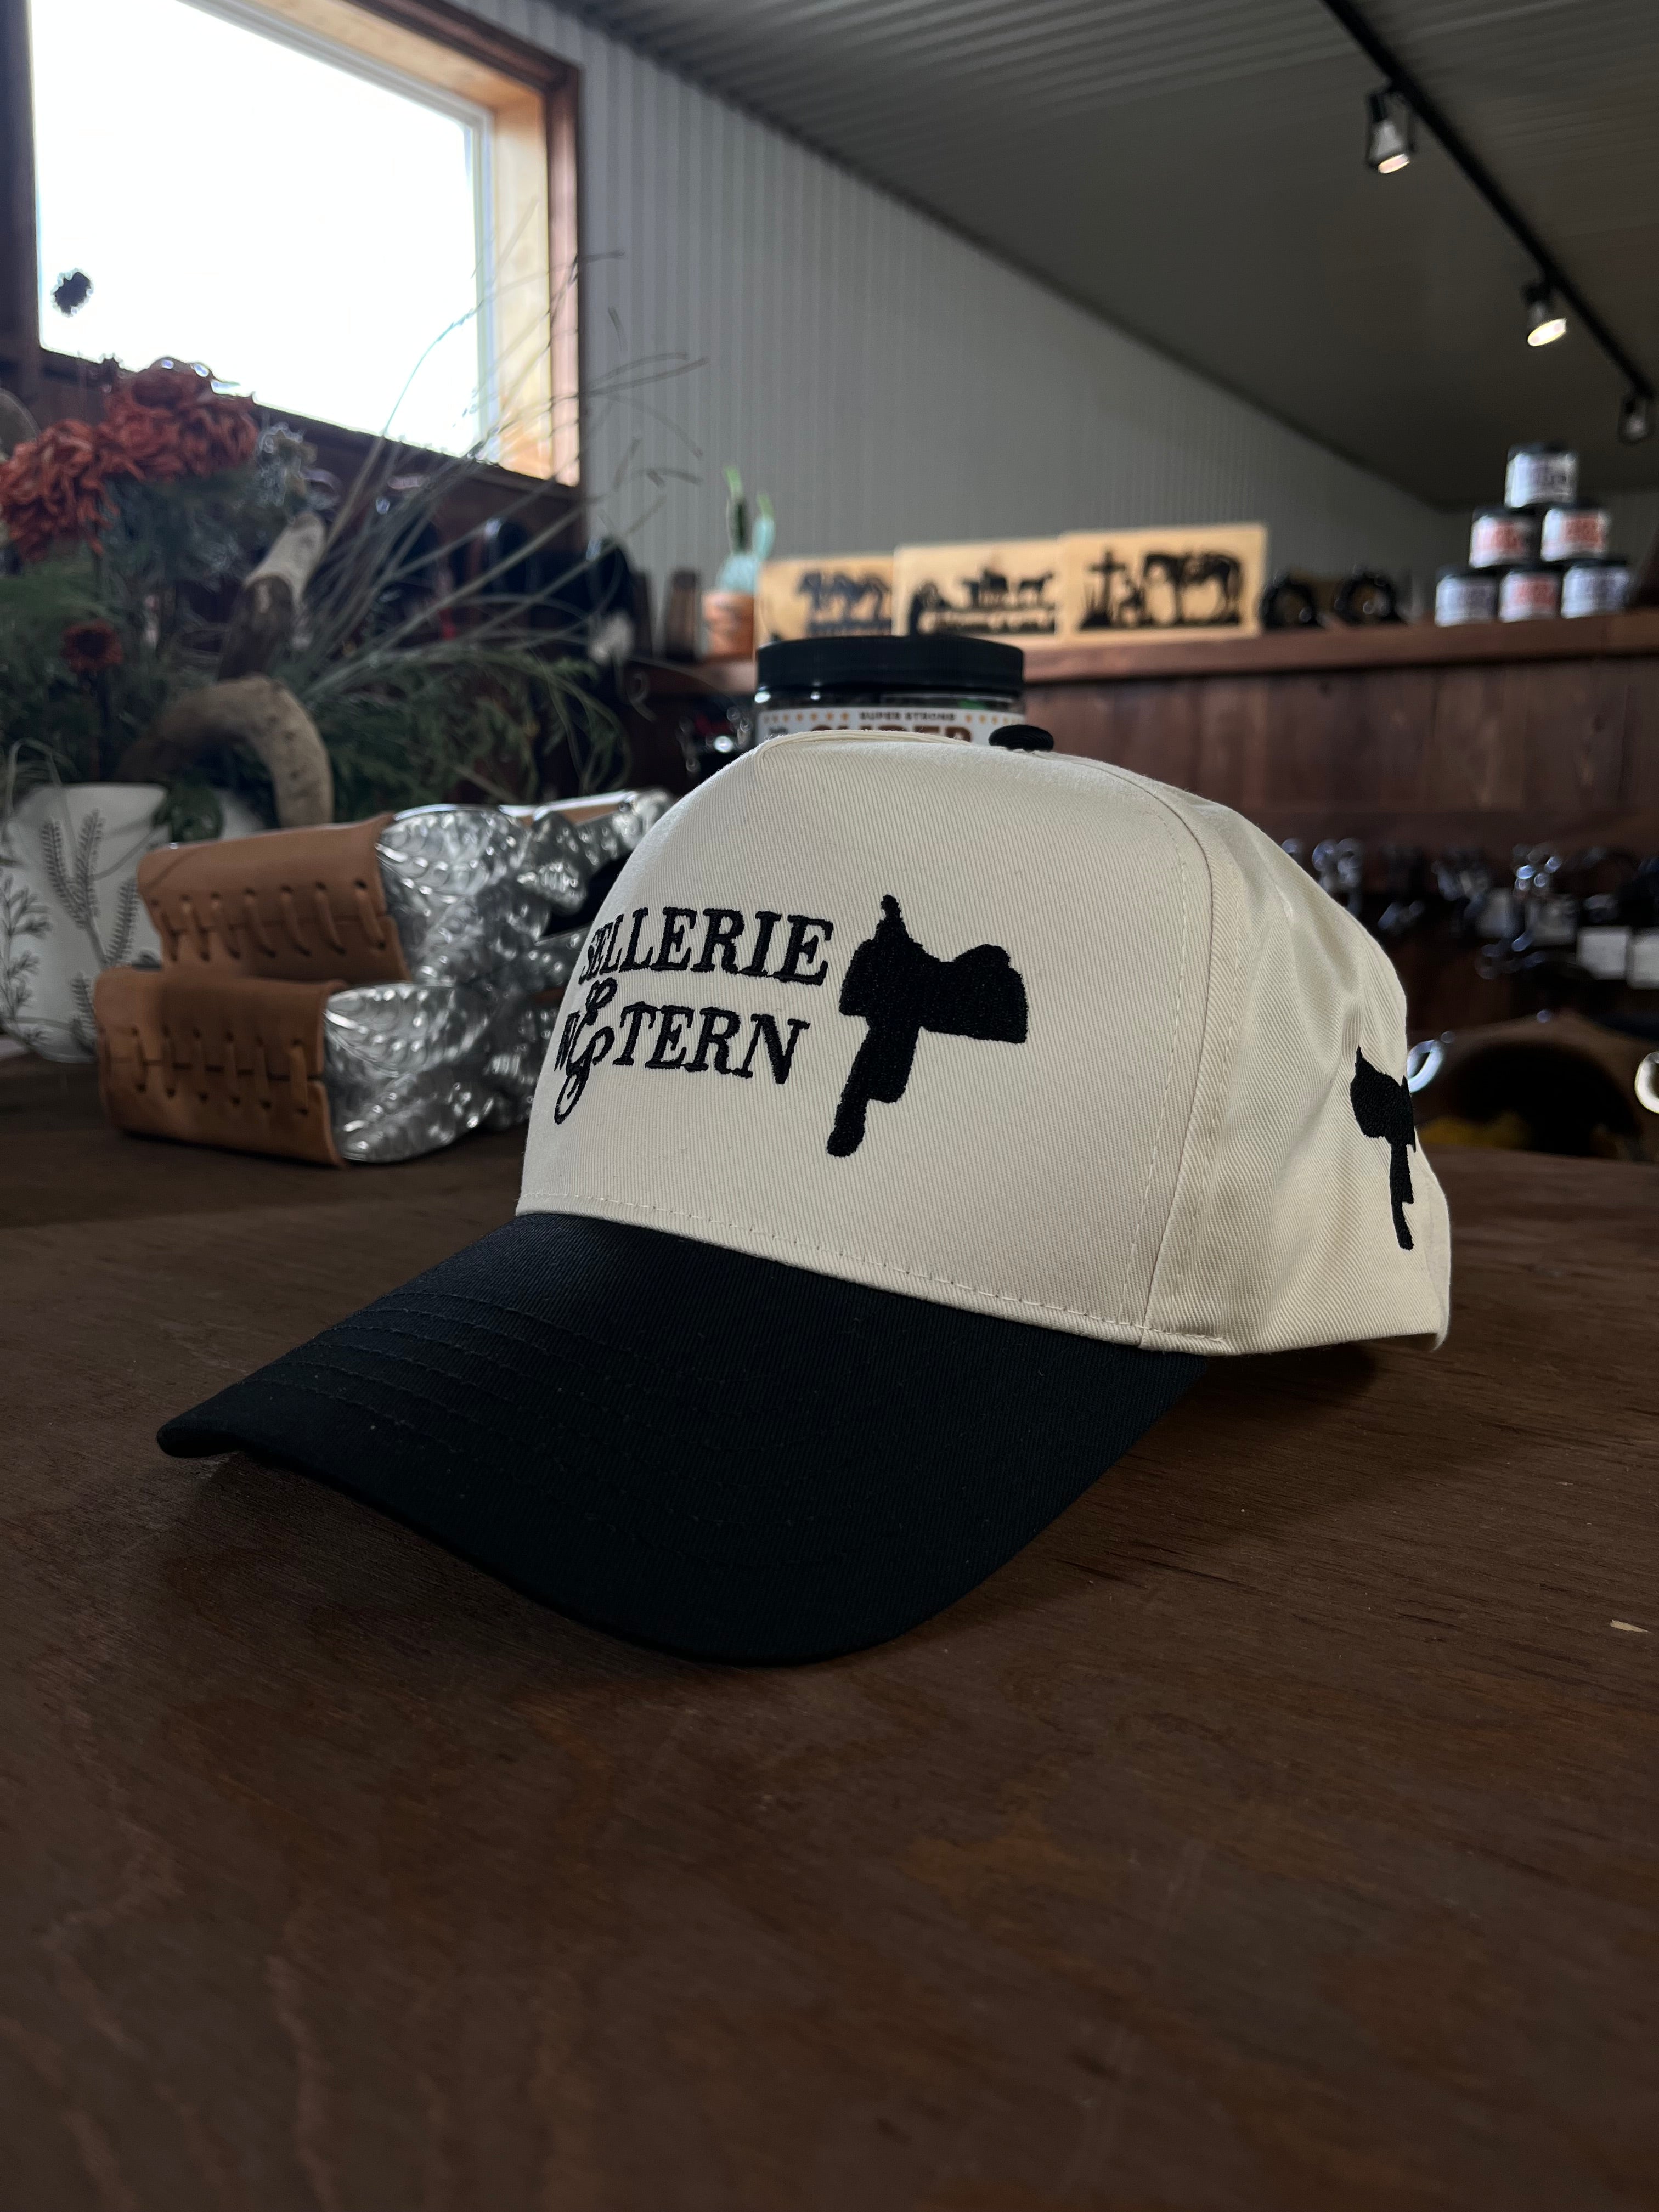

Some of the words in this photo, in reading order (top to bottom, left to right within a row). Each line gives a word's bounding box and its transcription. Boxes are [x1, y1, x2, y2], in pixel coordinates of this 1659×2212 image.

[859, 711, 901, 721] SUPER
[905, 711, 956, 721] STRONG
[578, 906, 834, 986] SELLERIE
